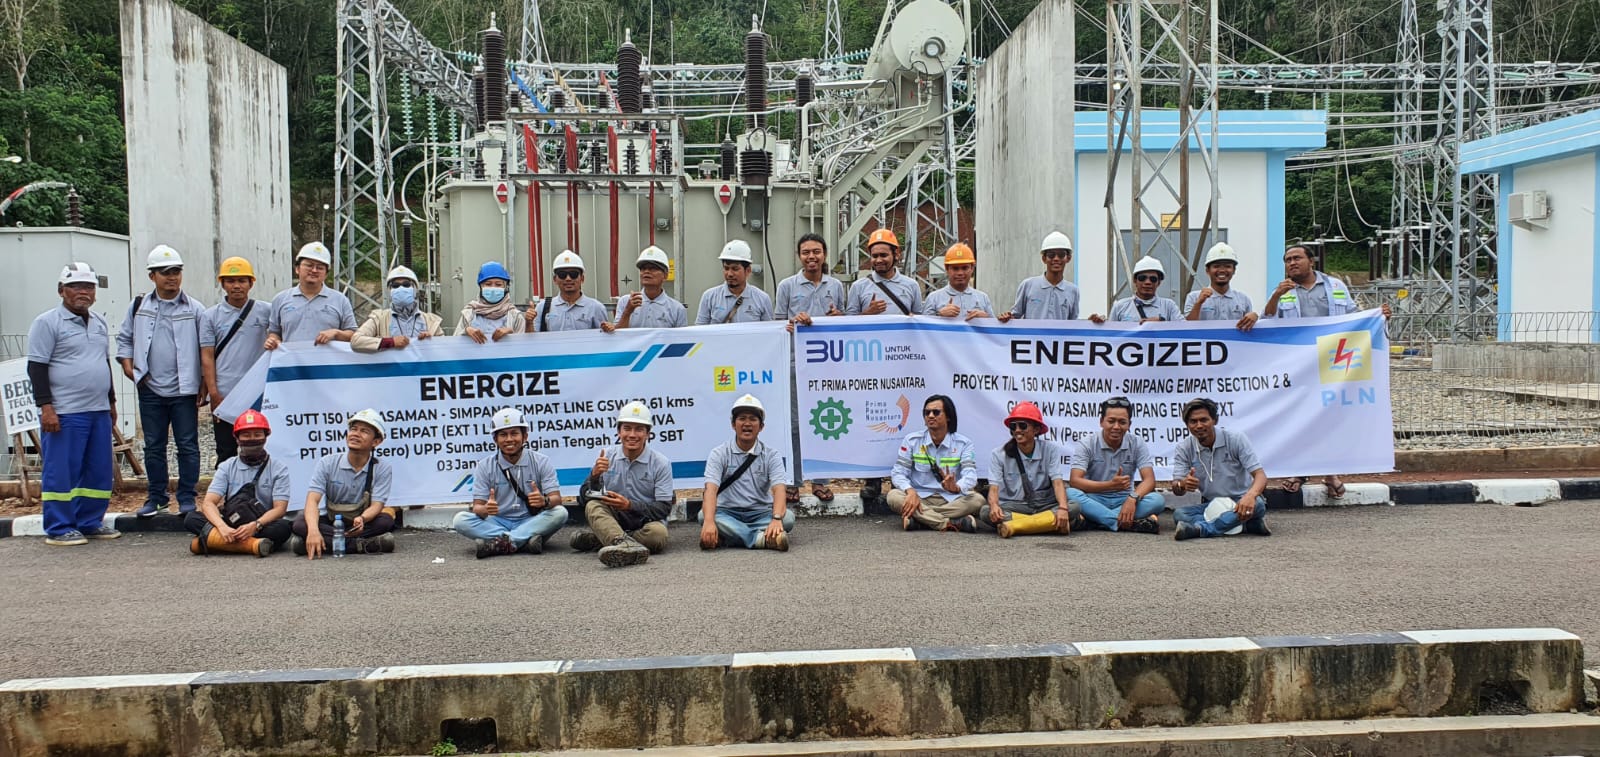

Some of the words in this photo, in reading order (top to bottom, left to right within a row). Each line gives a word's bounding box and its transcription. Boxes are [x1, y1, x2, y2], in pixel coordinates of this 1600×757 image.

[1010, 340, 1228, 367] ENERGIZED
[420, 371, 560, 400] ENERGIZE
[738, 370, 773, 384] PLN
[808, 380, 820, 392] PT.
[822, 380, 847, 391] PRIMA
[848, 378, 878, 390] POWER
[880, 376, 926, 390] NUSANTARA
[953, 373, 998, 391] PROYEK
[1002, 376, 1018, 392] T/L
[1021, 376, 1038, 392] 150
[1042, 377, 1054, 392] kV
[1058, 377, 1112, 393] PASAMAN
[1122, 378, 1174, 394] SIMPANG
[1176, 378, 1214, 394] EMPAT
[1217, 376, 1269, 392] SECTION
[1272, 374, 1280, 389] 2
[1283, 373, 1291, 388] &
[1321, 387, 1376, 407] PLN
[286, 412, 319, 426] SUTT
[322, 412, 343, 424] 150
[564, 400, 594, 413] LINE
[666, 396, 694, 408] kms
[1043, 402, 1055, 416] kV
[308, 430, 322, 442] GI
[391, 426, 438, 440] EMPAT
[442, 424, 470, 440] (EXT
[473, 424, 478, 435] 1
[538, 418, 604, 432] PASAMAN
[300, 448, 316, 460] PT
[414, 443, 442, 456] UPP
[562, 434, 610, 449] Tengah
[660, 430, 684, 442] SBT
[437, 460, 452, 471] 03
